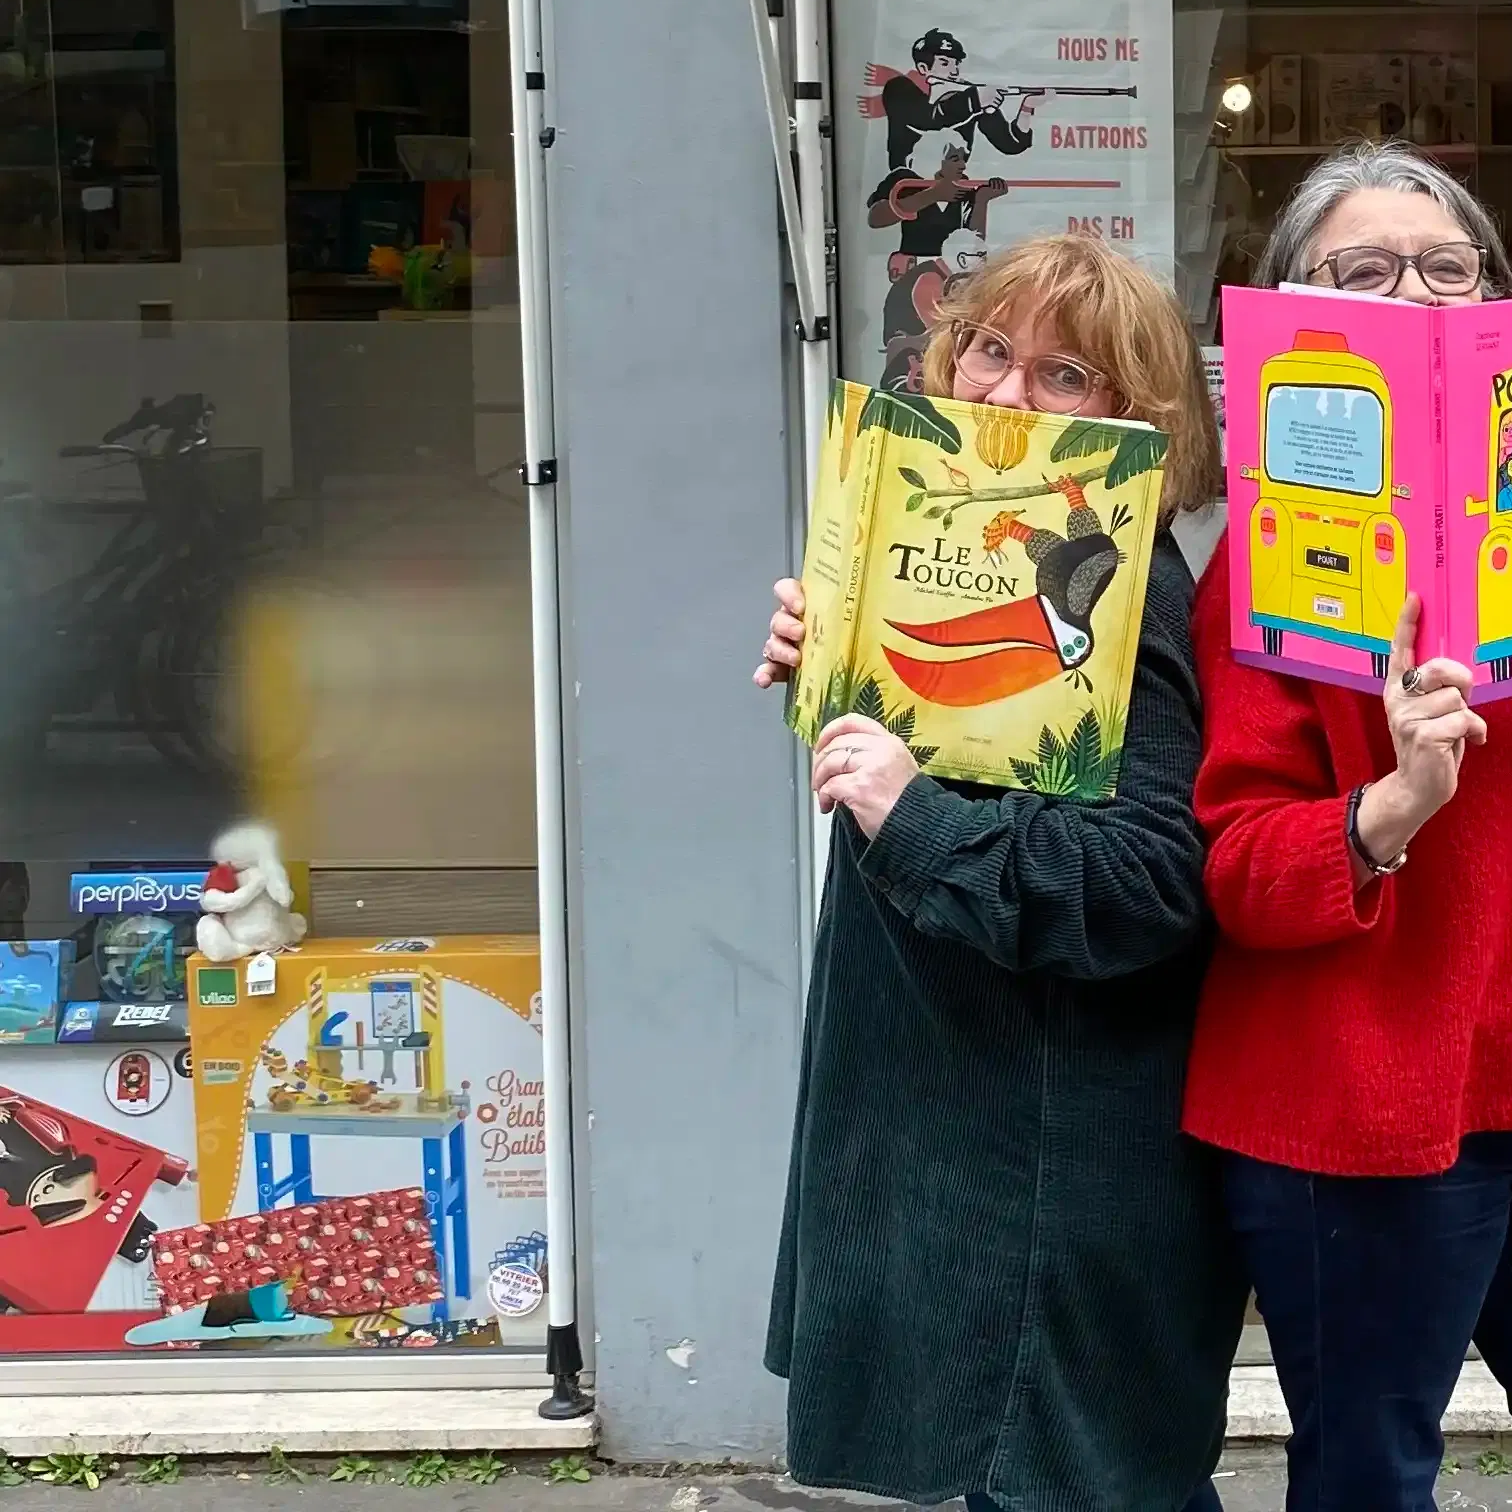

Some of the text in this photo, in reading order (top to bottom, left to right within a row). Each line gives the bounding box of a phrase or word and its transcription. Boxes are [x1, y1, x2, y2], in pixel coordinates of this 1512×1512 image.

[1057, 37, 1139, 62] NOUS NE
[1051, 124, 1148, 149] BATTRONS
[1110, 216, 1135, 239] EN
[931, 537, 971, 566] LE
[1317, 554, 1338, 567] POUET
[889, 543, 1019, 597] TOUCON
[79, 876, 203, 912] perplexus
[200, 994, 236, 1004] vilac
[113, 1004, 173, 1026] REBEL
[500, 1269, 538, 1287] VITRIER
